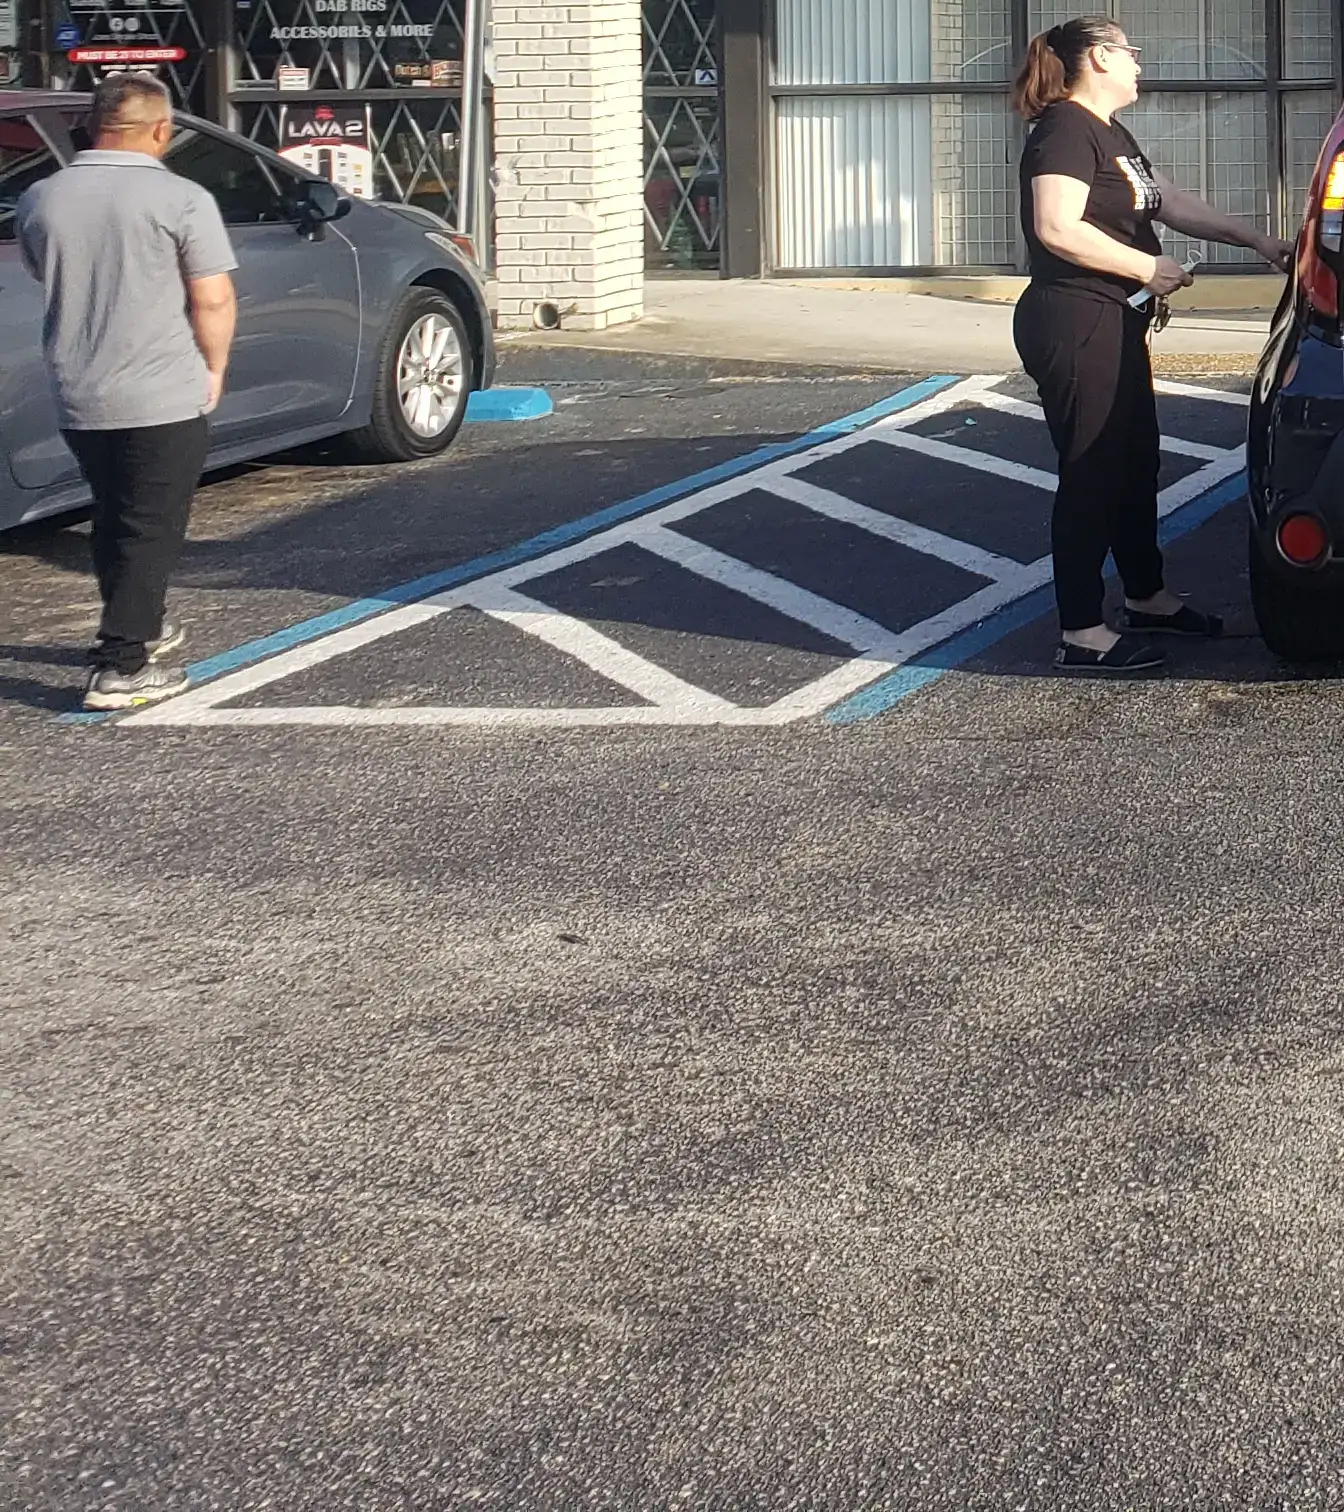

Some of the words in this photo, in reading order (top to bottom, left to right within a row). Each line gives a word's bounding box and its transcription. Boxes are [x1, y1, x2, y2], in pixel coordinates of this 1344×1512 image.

[315, 0, 348, 12] DAB
[350, 0, 387, 11] RIGS
[375, 25, 387, 37] &
[390, 24, 434, 37] MORE
[77, 51, 102, 60] MUST
[131, 50, 144, 58] TO
[146, 49, 177, 58] ENTER
